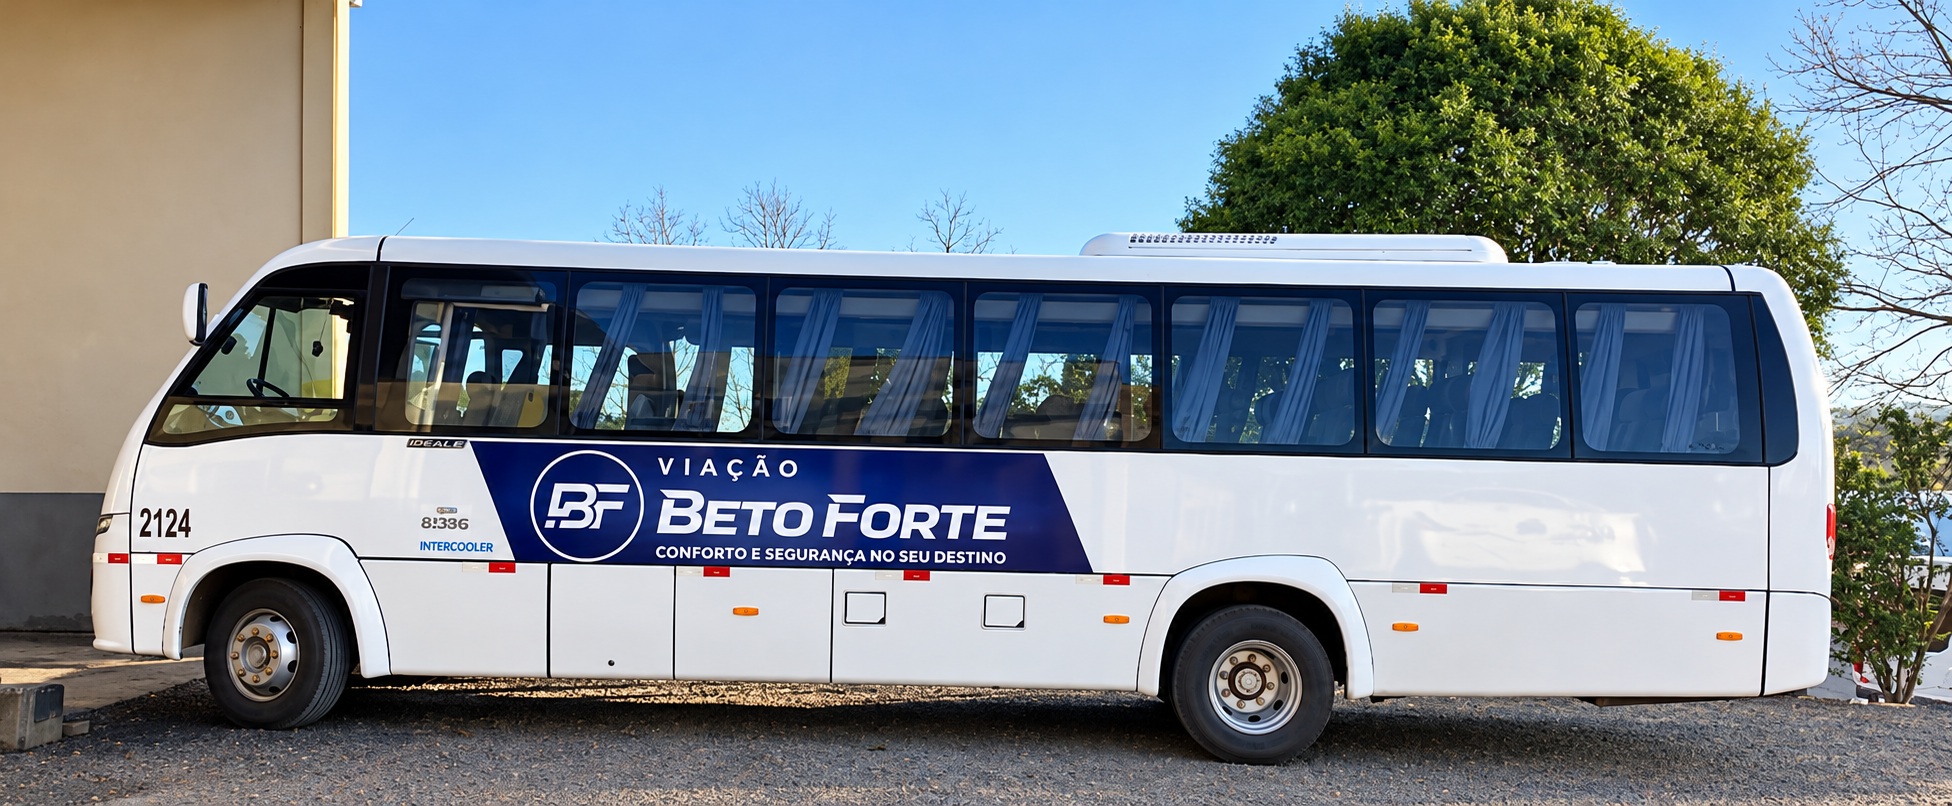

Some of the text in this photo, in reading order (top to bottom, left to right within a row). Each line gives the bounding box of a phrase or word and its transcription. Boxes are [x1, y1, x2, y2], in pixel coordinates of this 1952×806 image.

[409, 439, 465, 447] IDEALE
[658, 454, 798, 482] VIAÇÃO
[139, 507, 192, 538] 2124
[656, 489, 1011, 541] BETO FORTE
[420, 541, 494, 553] INTERCOOLER
[655, 545, 1007, 566] CONFORTO E SEGURANÇA NO SEU DESTINO
